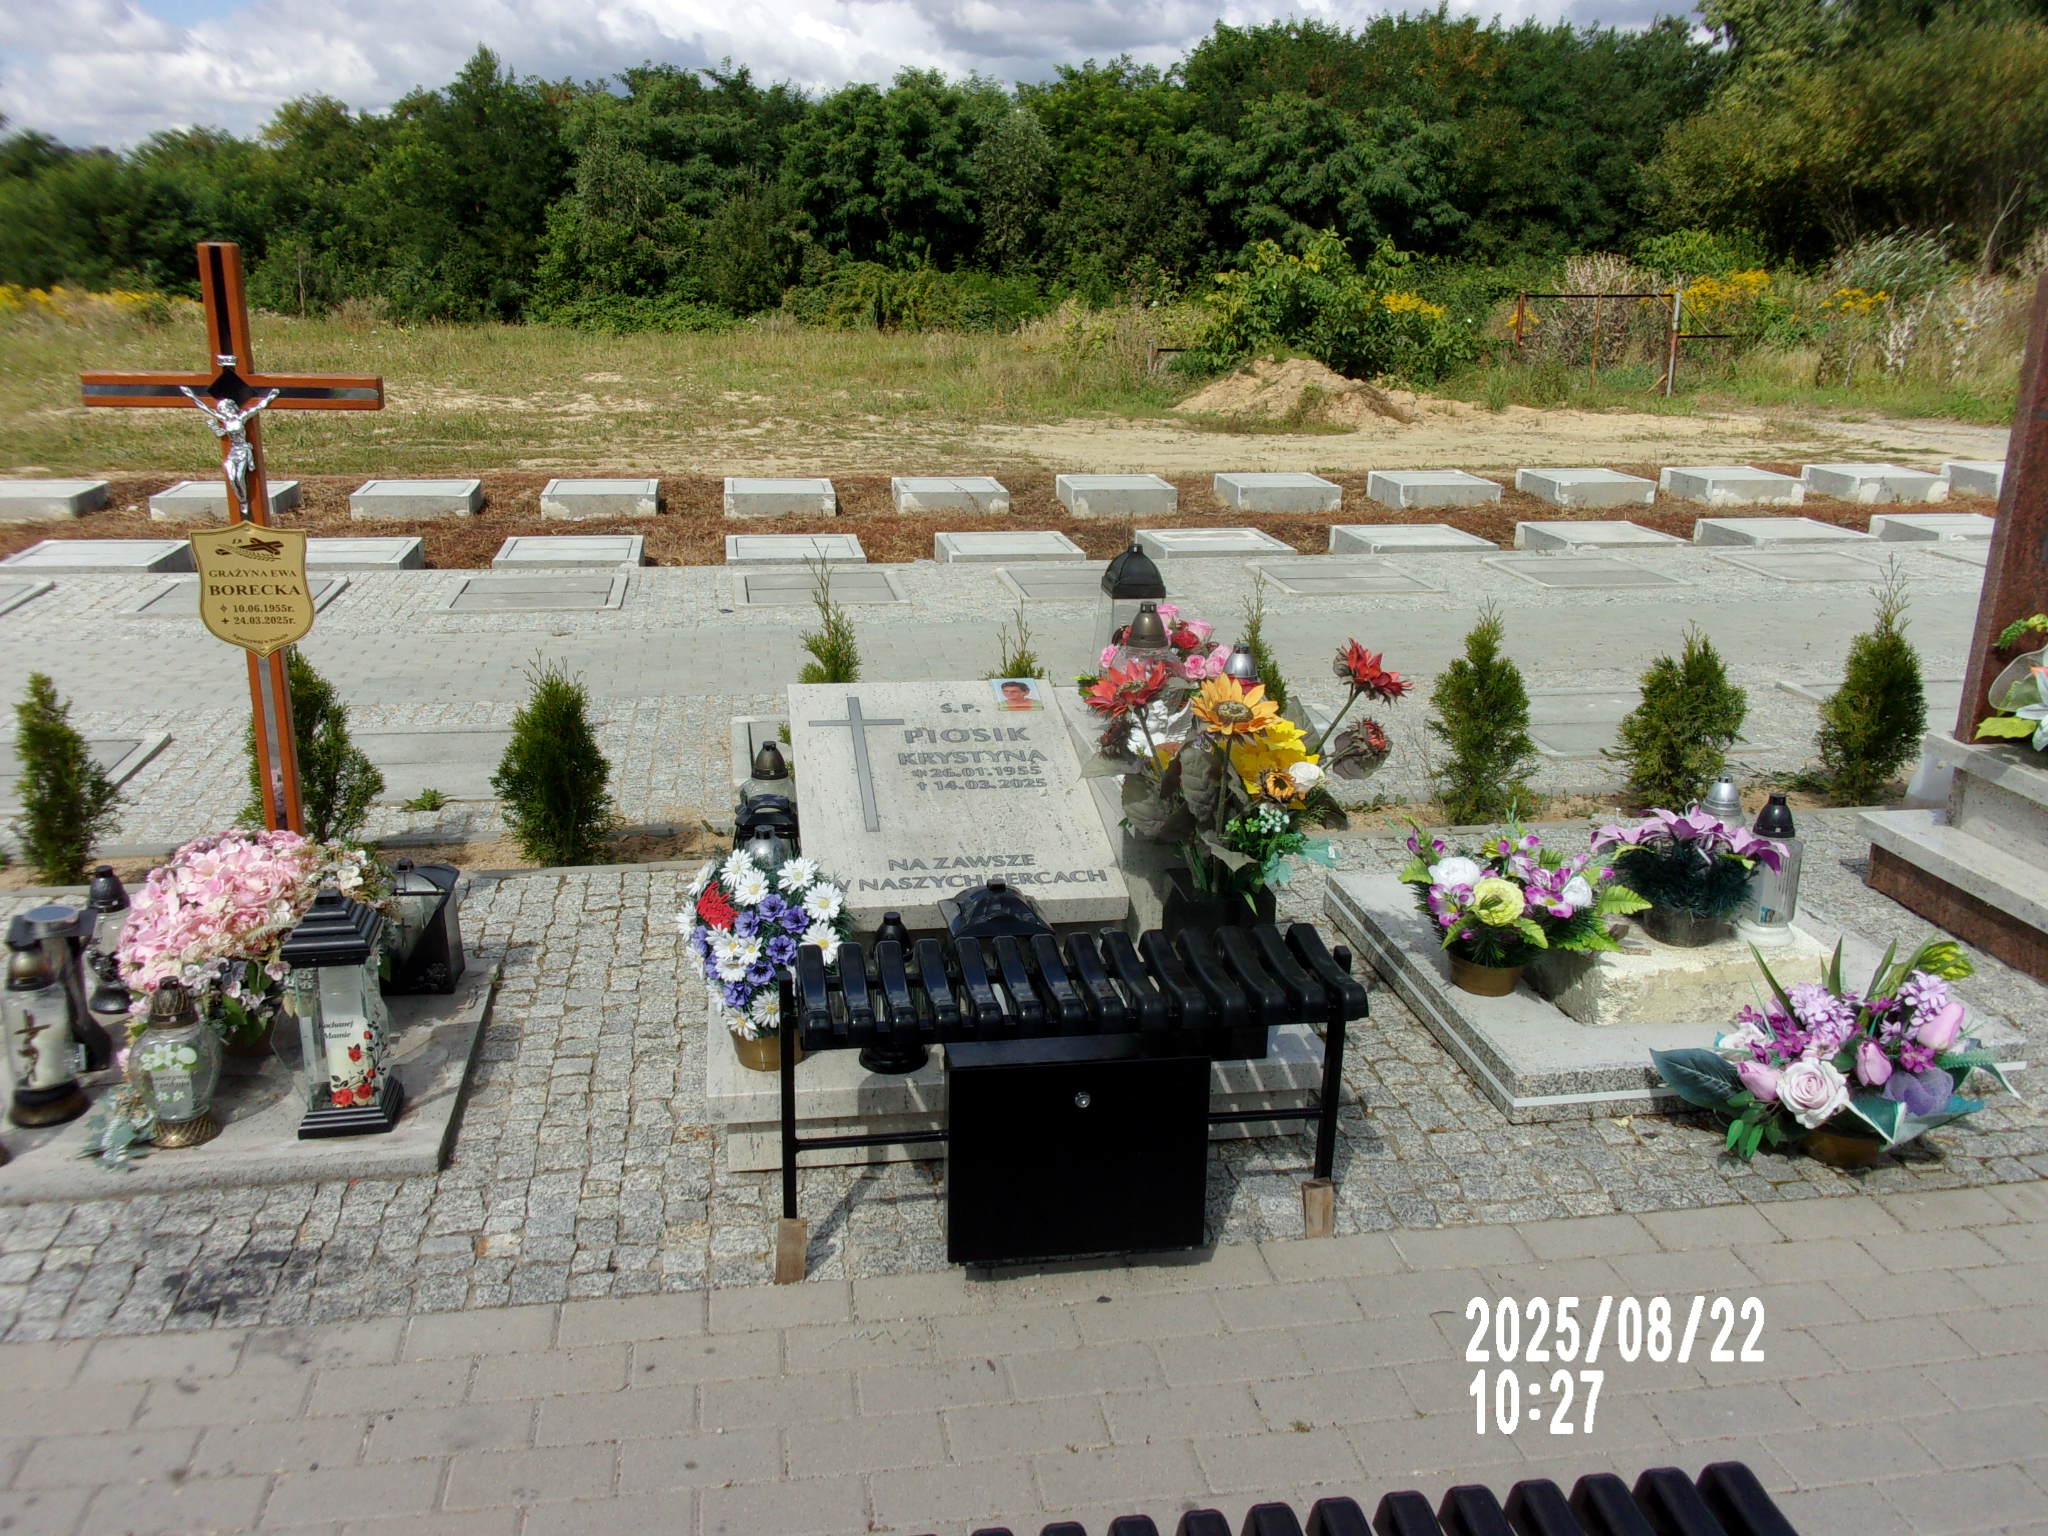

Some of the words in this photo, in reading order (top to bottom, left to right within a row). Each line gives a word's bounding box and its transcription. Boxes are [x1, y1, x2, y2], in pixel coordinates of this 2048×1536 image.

[209, 568, 268, 577] GRAŻYNA
[209, 585, 301, 596] BORECKA
[904, 727, 1031, 744] PIOSIK
[898, 750, 1048, 765] KRYSTYNA
[888, 858, 927, 872] NA
[933, 854, 1036, 869] ZAWSZE
[858, 874, 984, 892] NASZYCH
